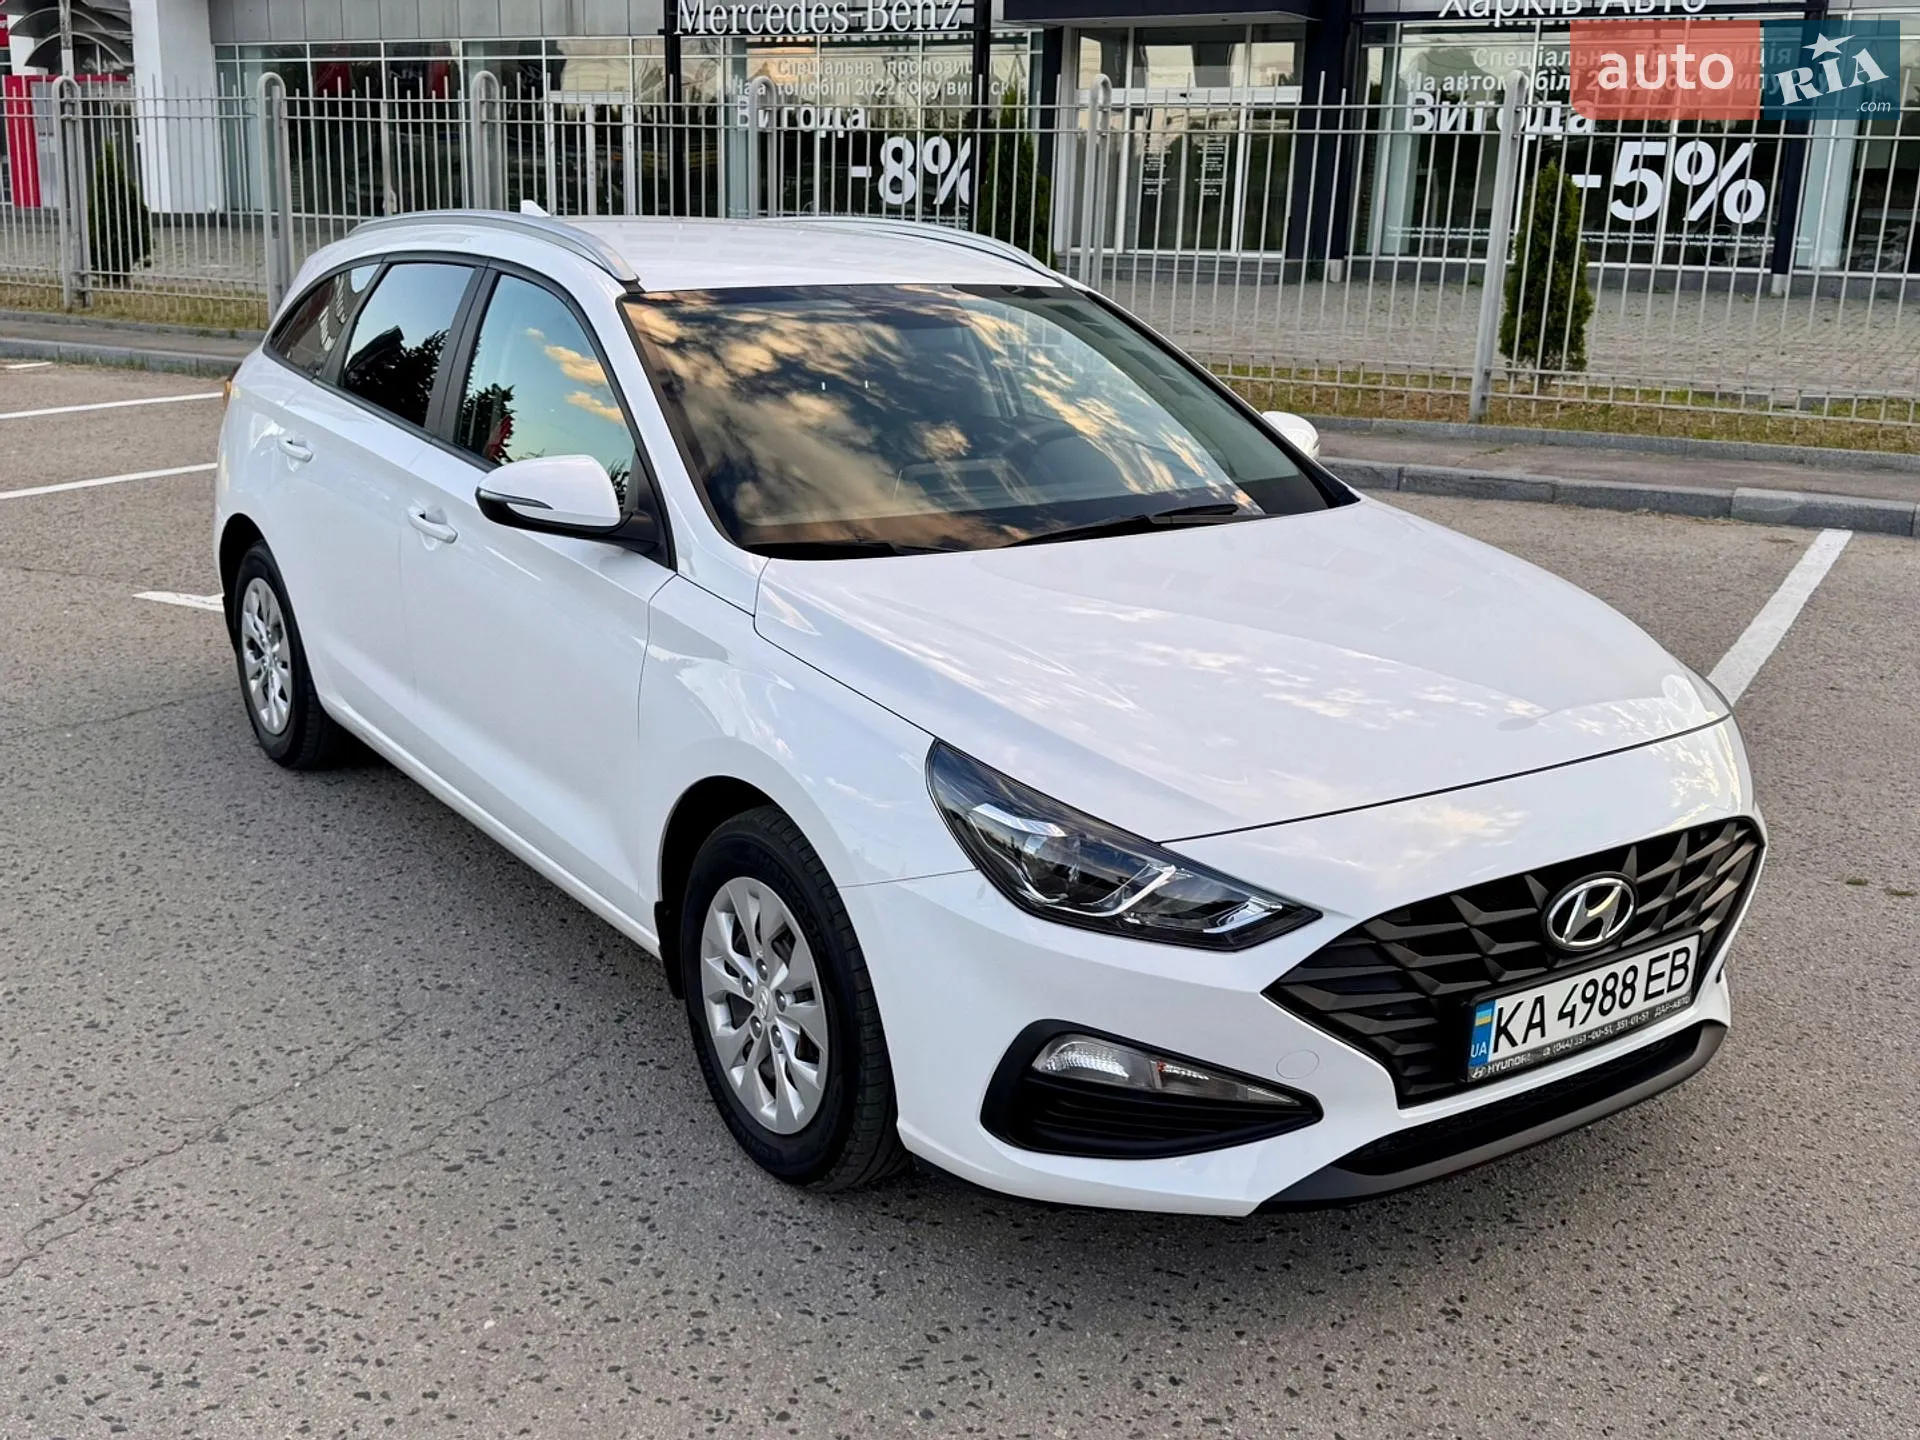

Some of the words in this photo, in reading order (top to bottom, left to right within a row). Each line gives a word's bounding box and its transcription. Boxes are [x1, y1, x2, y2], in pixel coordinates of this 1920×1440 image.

[674, 0, 962, 35] Mercedes-Benz
[757, 78, 850, 97] атомобілі
[855, 78, 896, 97] 2022
[851, 135, 971, 206] -8%
[1571, 140, 1767, 225] -5%
[1493, 995, 1547, 1054] KA
[1557, 964, 1640, 1030] 4988
[1643, 946, 1691, 1003] EB
[1470, 1041, 1488, 1058] UA
